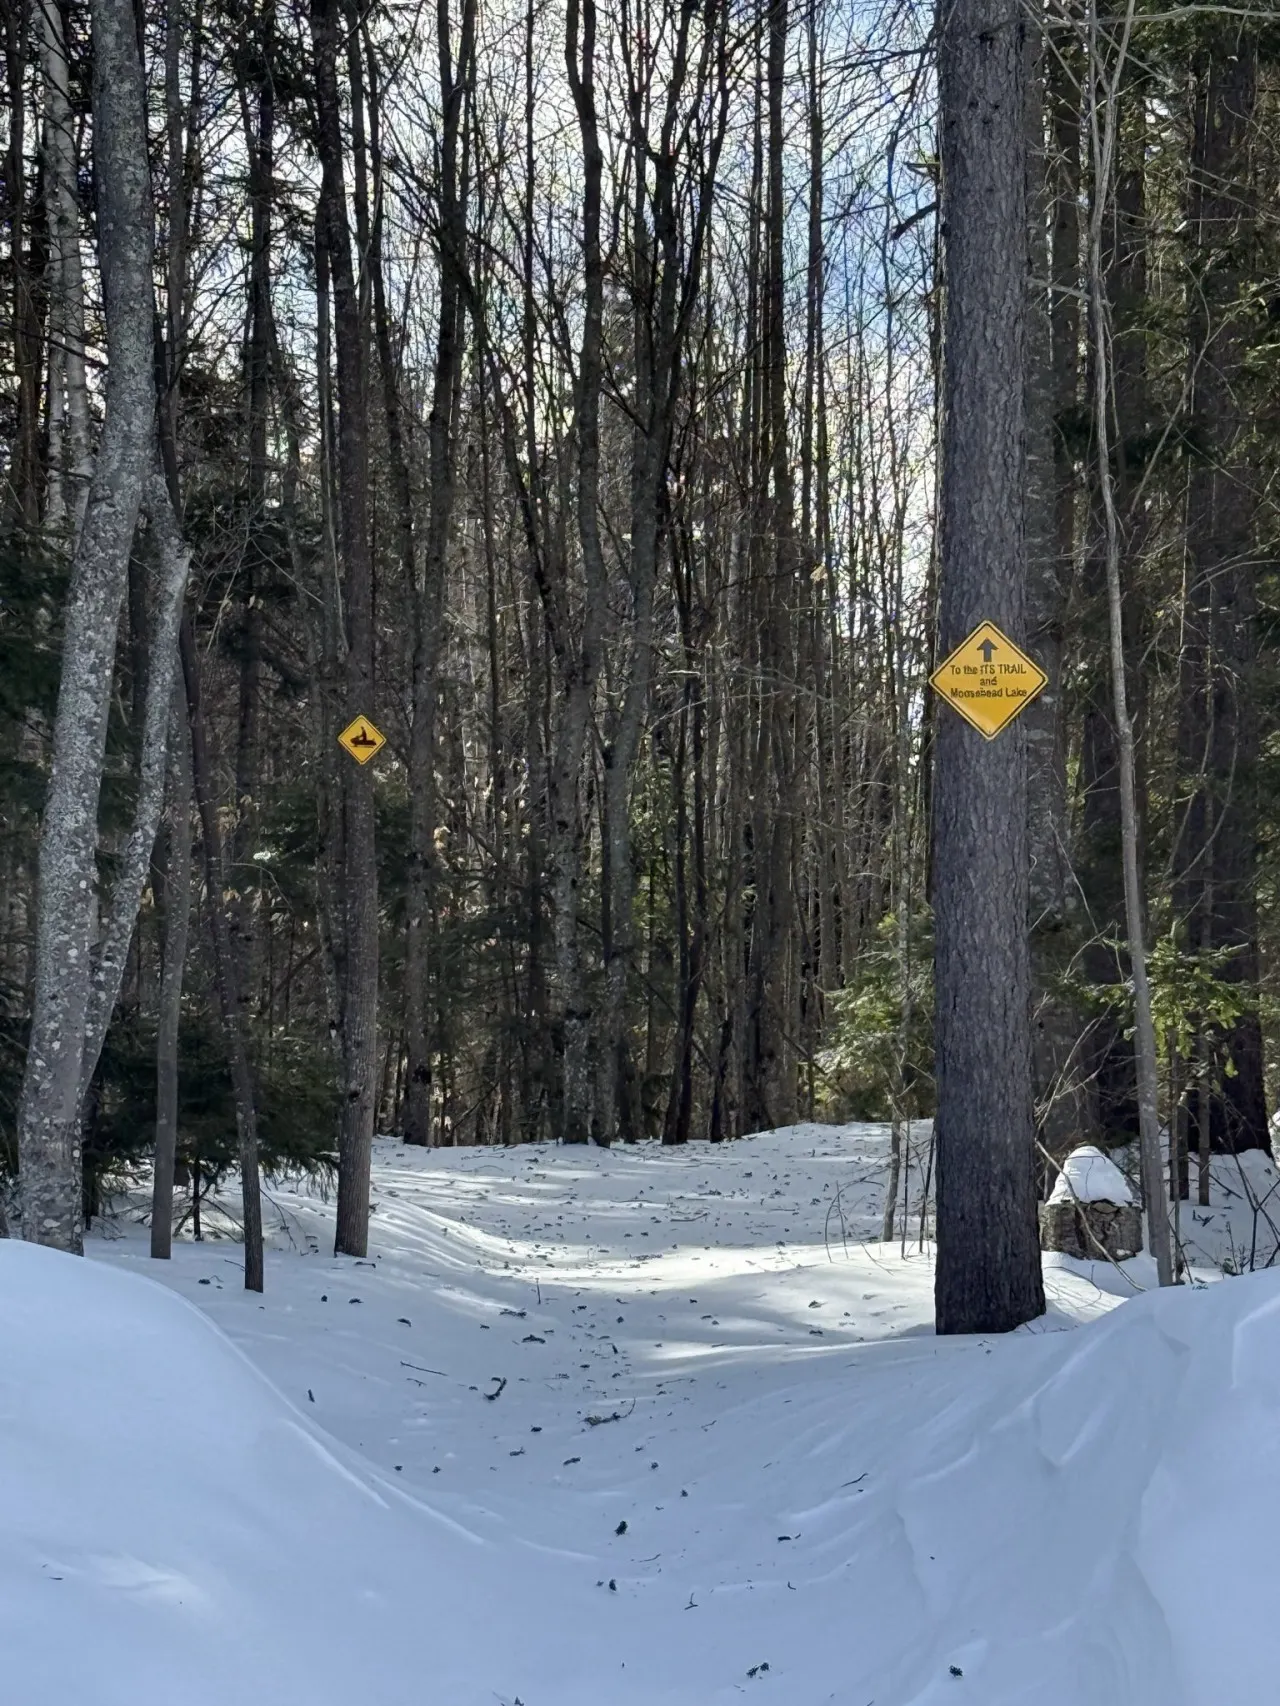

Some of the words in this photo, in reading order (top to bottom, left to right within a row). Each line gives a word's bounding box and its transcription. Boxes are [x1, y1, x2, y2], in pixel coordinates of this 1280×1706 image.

[950, 665, 961, 675] To
[963, 665, 978, 675] the
[980, 664, 995, 675] ITS
[997, 664, 1027, 675] TRAIL
[980, 676, 998, 686] and
[950, 687, 1003, 698] Moosehead
[1005, 687, 1027, 697] Lake
